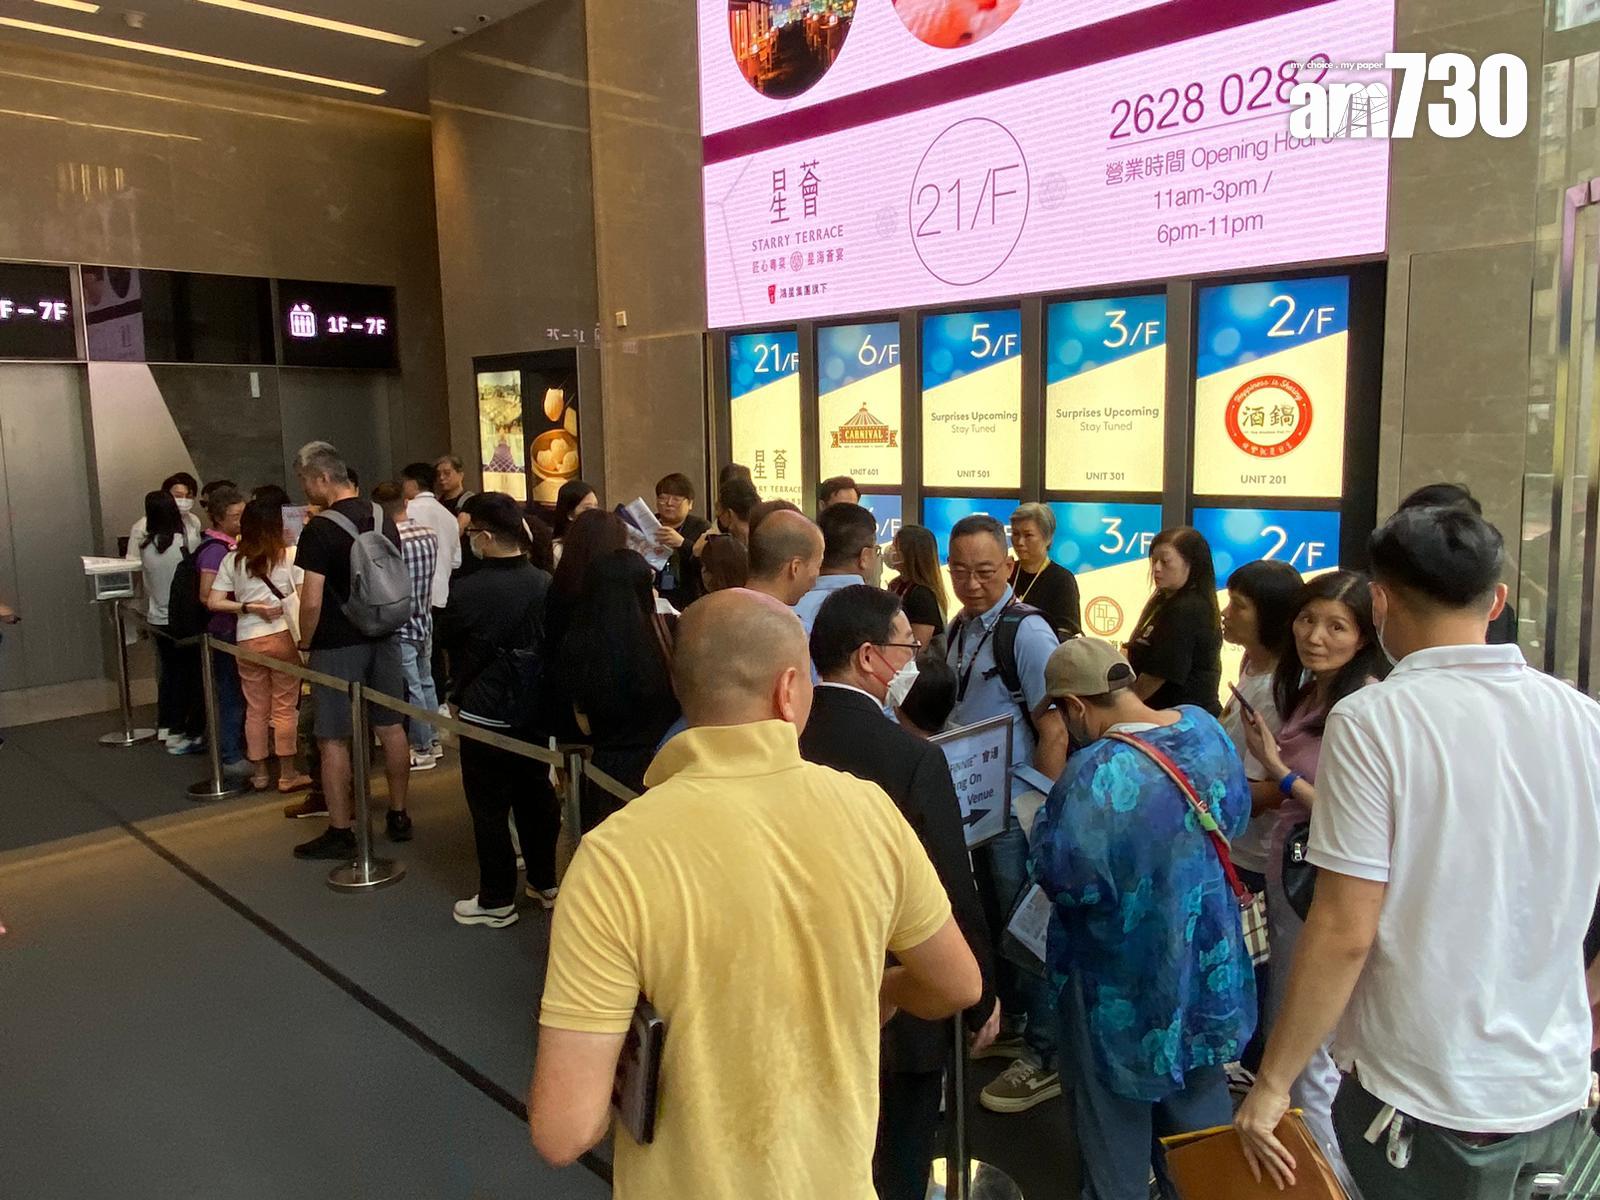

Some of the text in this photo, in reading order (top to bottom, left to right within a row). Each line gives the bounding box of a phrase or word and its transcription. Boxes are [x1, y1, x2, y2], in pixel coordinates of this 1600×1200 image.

[1109, 82, 1205, 140] 2628
[1105, 149, 1185, 186] 營業時間
[1191, 139, 1268, 170] Opening
[915, 163, 1020, 238] 21/F
[1153, 179, 1257, 209] 11am-3pm
[751, 224, 844, 252] STARRY TERRACE
[1157, 214, 1264, 247] 6pm-11pm
[1102, 310, 1160, 348] 3/F
[1267, 294, 1335, 338] 2/F
[858, 334, 900, 367] 6/F
[969, 323, 1018, 359] 5/F
[753, 343, 799, 374] 21/F
[931, 410, 1018, 423] Surprises Upcoming
[1055, 406, 1160, 419] Surprises Upcoming
[1079, 420, 1133, 432] Stay Tuned
[844, 429, 884, 440] CARNIVAL
[951, 422, 996, 434] Stay Tuned
[850, 468, 879, 476] UNIT 601
[957, 469, 990, 479] UNIT 501
[1085, 471, 1125, 481] UNIT 301
[1240, 475, 1287, 485] UNIT 201
[1099, 517, 1154, 555] 3/F
[1260, 525, 1325, 567] 2/F
[969, 773, 982, 785] On
[967, 788, 994, 806] Venue
